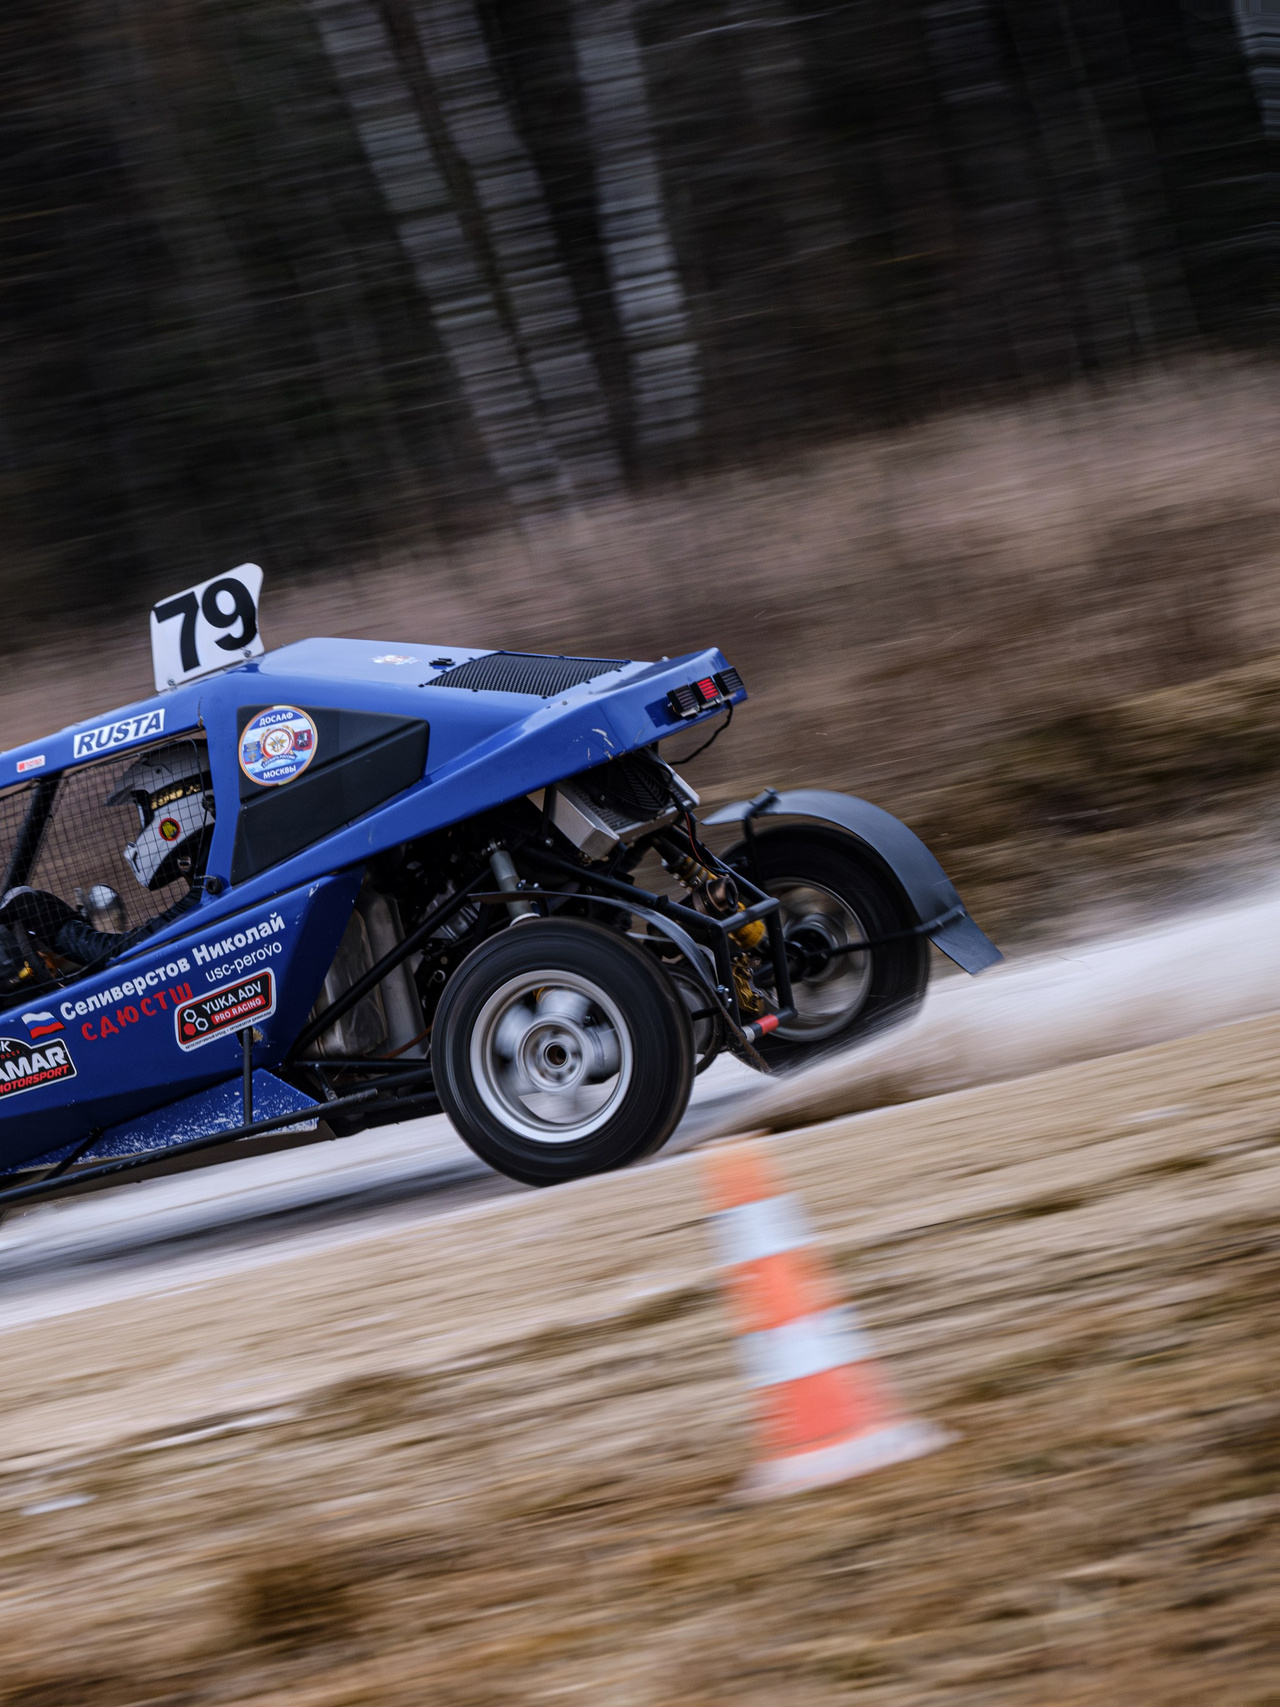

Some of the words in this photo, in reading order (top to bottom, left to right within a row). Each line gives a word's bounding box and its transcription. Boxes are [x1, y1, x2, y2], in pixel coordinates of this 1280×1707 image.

[154, 578, 257, 672] 79
[76, 712, 162, 755] RUSTA
[259, 712, 294, 726] ДОСААФ
[263, 765, 297, 779] МОСКВЫ
[60, 957, 191, 1020] Селиверстов
[191, 912, 286, 966] Николай
[205, 942, 283, 982] usc-perovo
[202, 993, 238, 1014] YUKA
[238, 981, 262, 1001] ADV
[214, 1012, 231, 1022] PRO
[232, 998, 262, 1016] RACING
